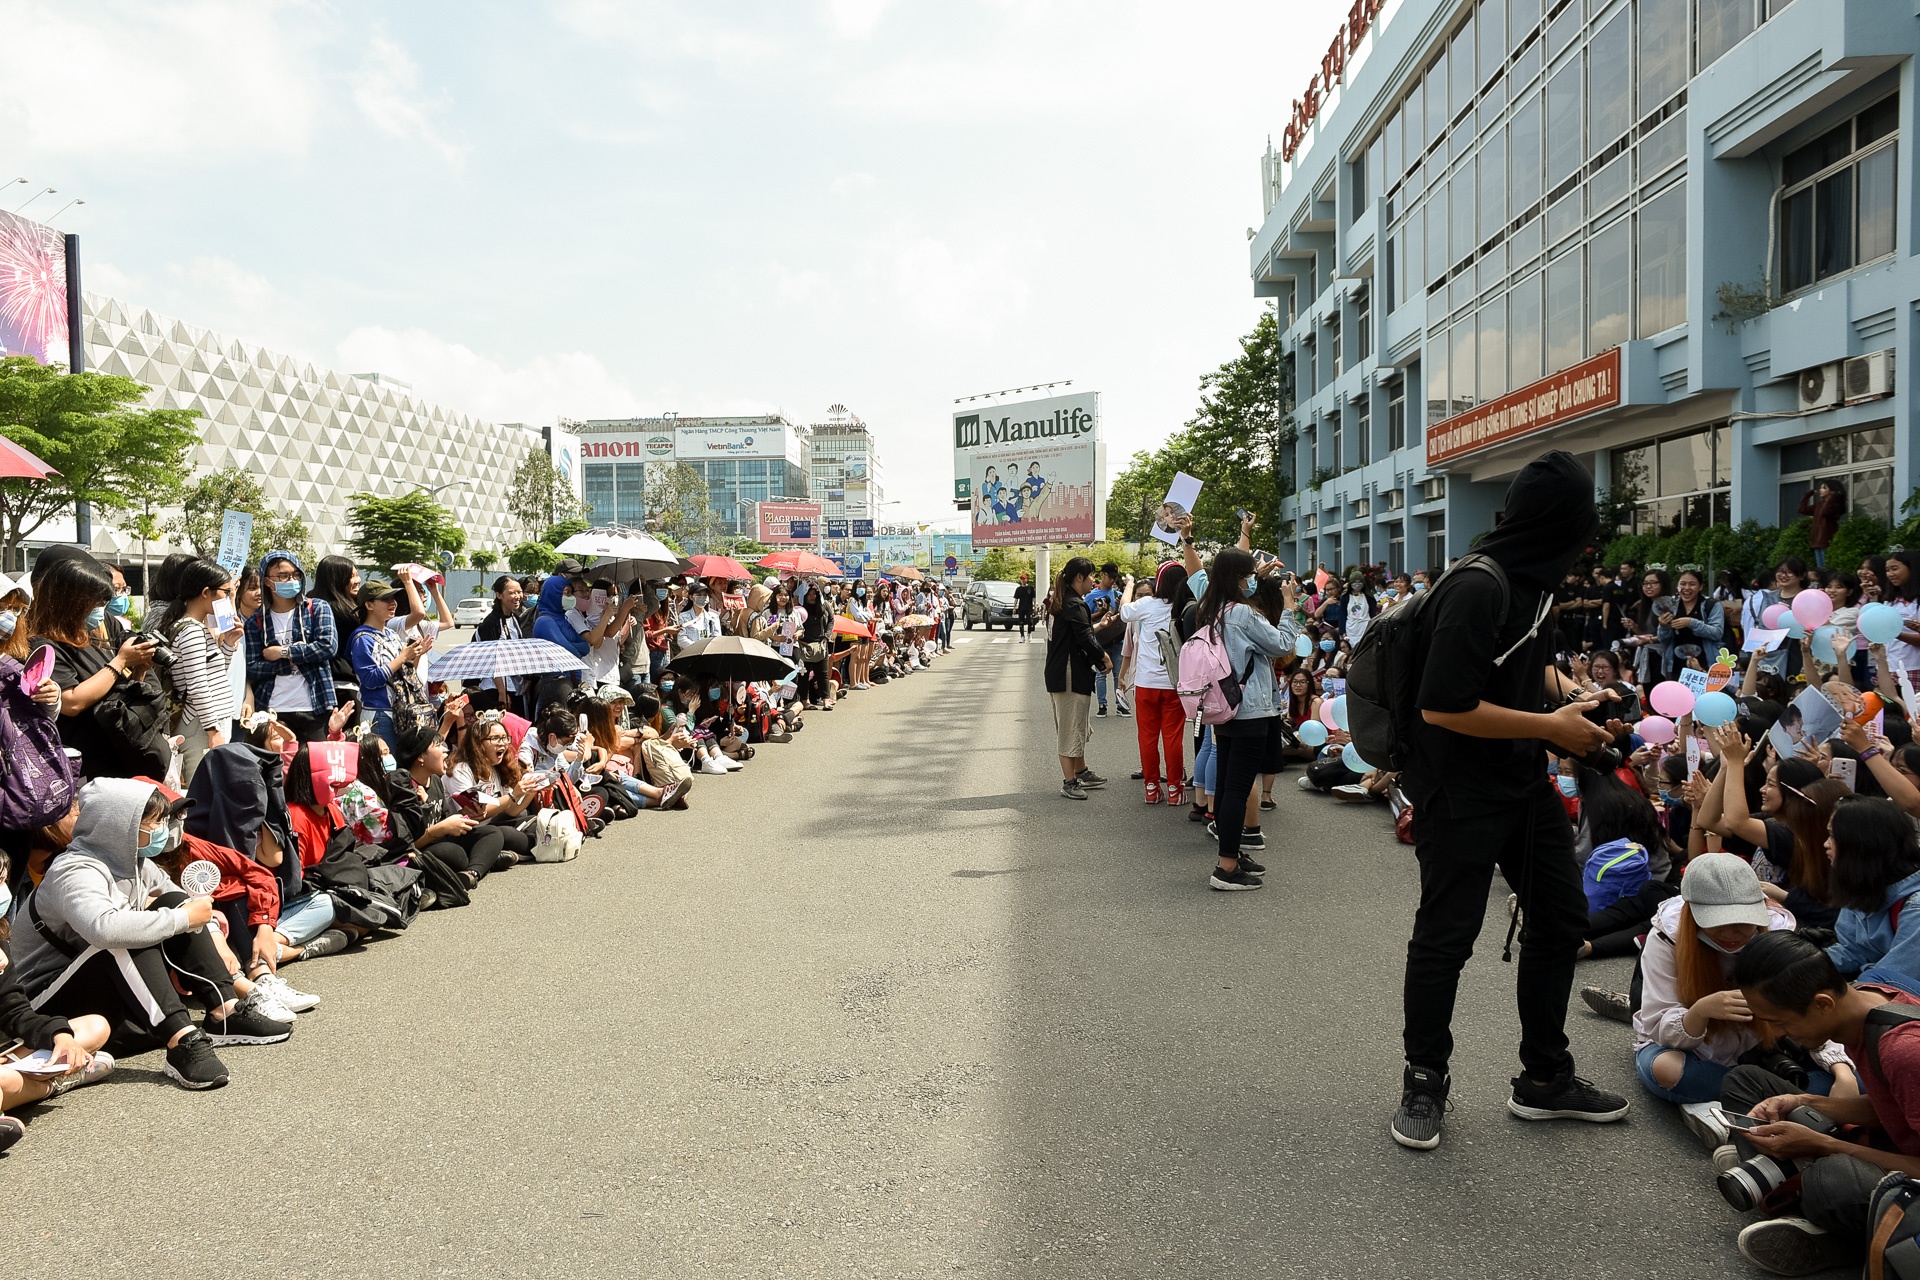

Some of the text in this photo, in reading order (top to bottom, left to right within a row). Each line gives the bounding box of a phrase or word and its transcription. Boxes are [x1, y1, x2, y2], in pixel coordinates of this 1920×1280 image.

[1510, 401, 1528, 428] TRONG
[1537, 384, 1558, 420] NGHIỆP
[1559, 376, 1572, 411] CỦA
[1573, 370, 1596, 406] CHÚNG
[984, 407, 1093, 444] Manulife
[581, 442, 639, 457] anon
[774, 515, 816, 524] AGRIBANK
[873, 527, 916, 536] HDBank
